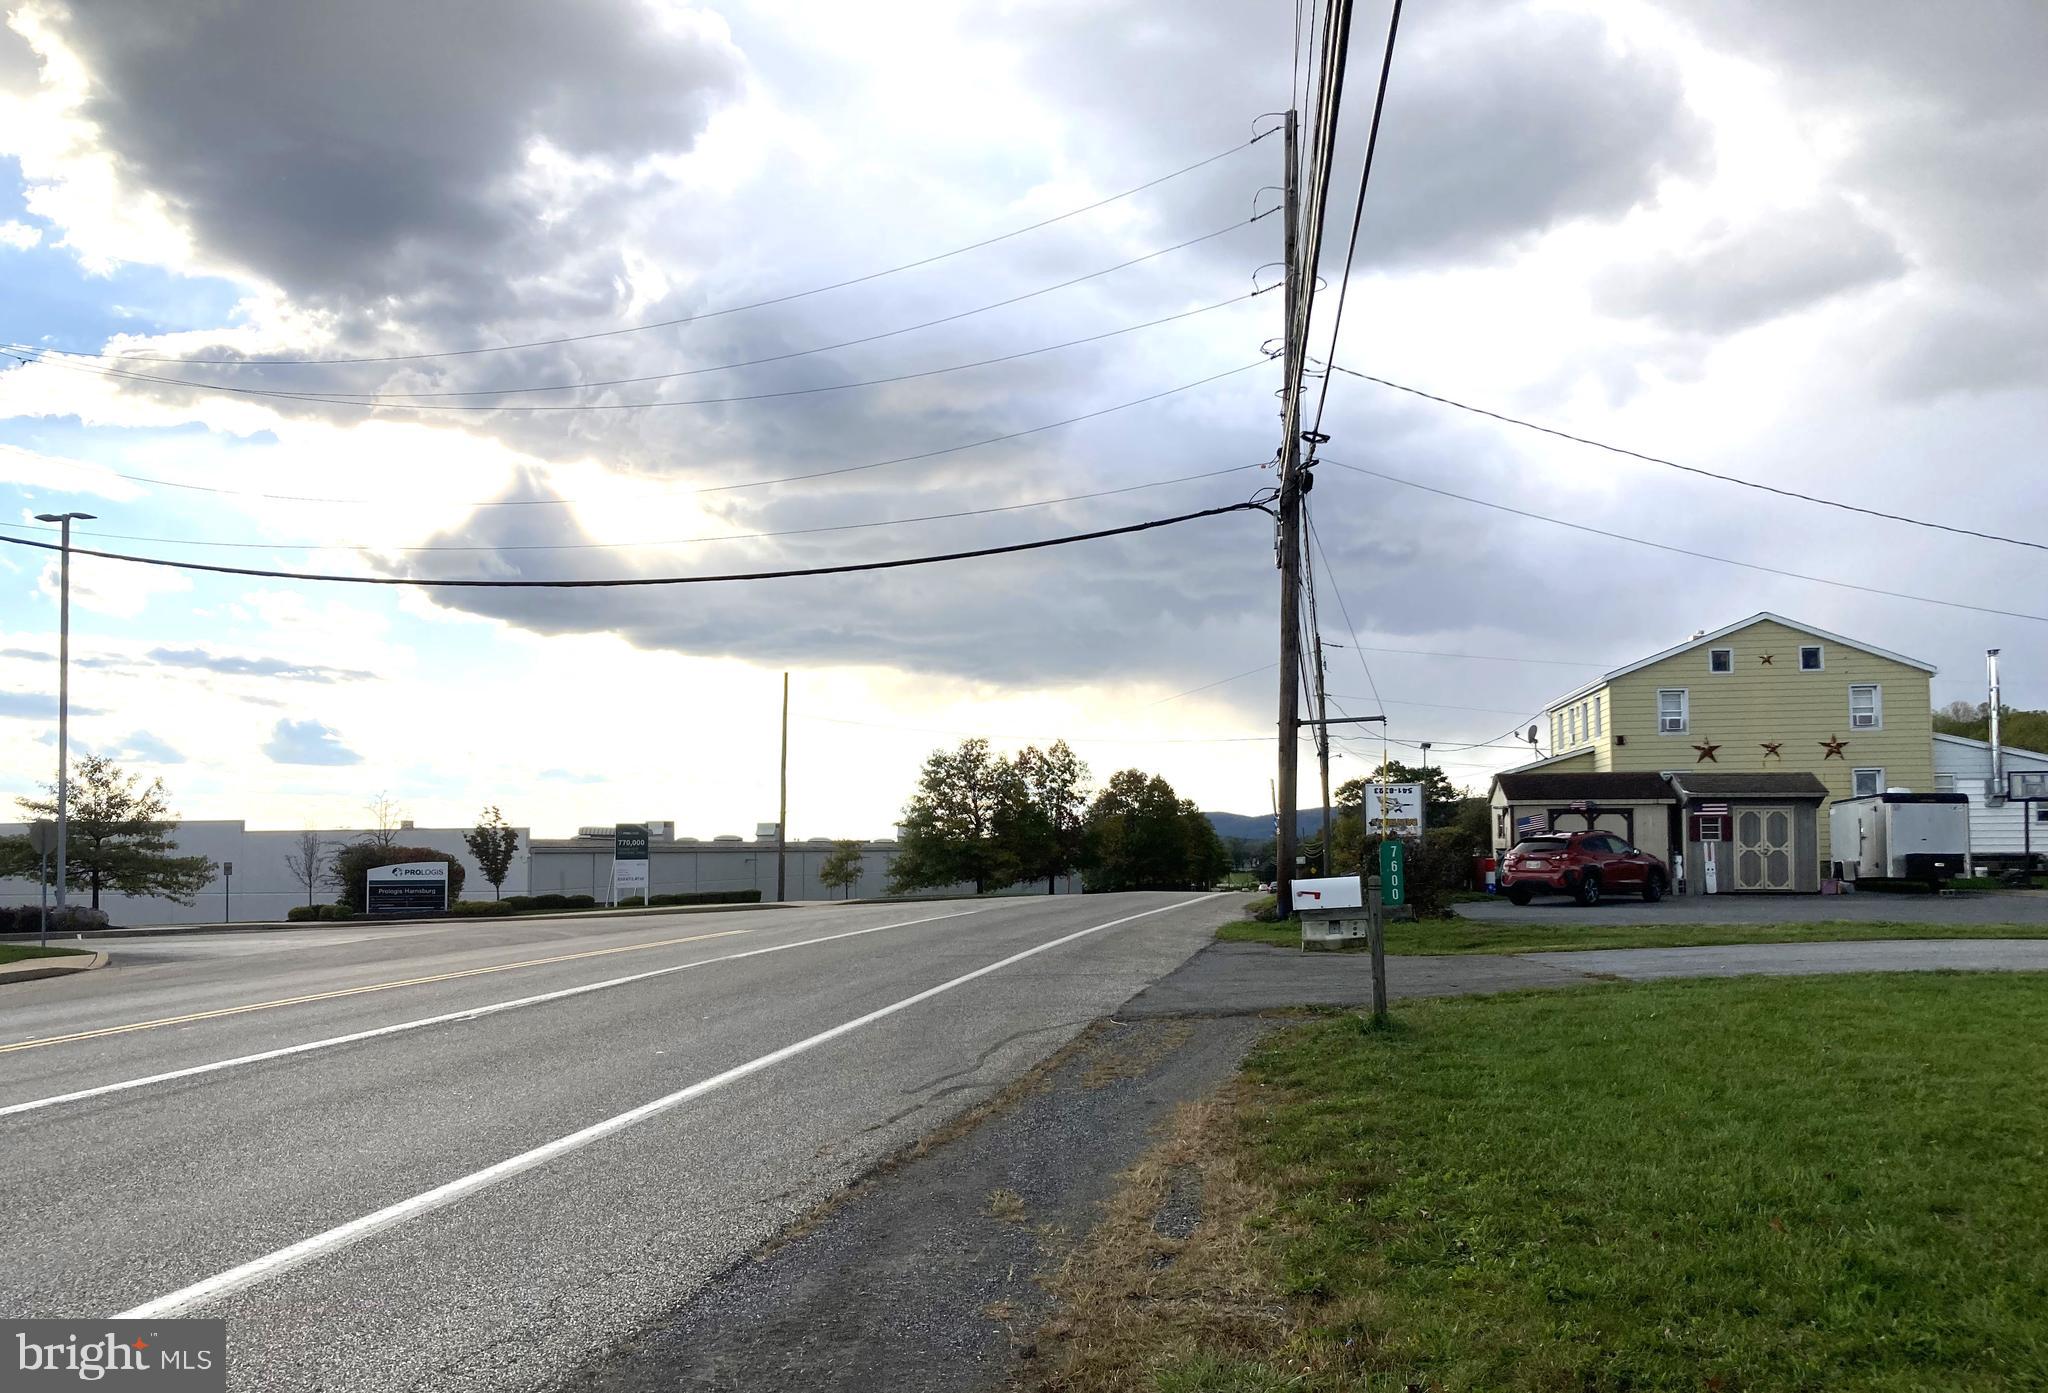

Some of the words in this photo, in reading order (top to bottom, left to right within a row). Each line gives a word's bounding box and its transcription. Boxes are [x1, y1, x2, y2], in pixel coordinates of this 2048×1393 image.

[618, 839, 645, 847] 770,000
[1390, 845, 1399, 900] 7600
[378, 888, 403, 896] Prologis
